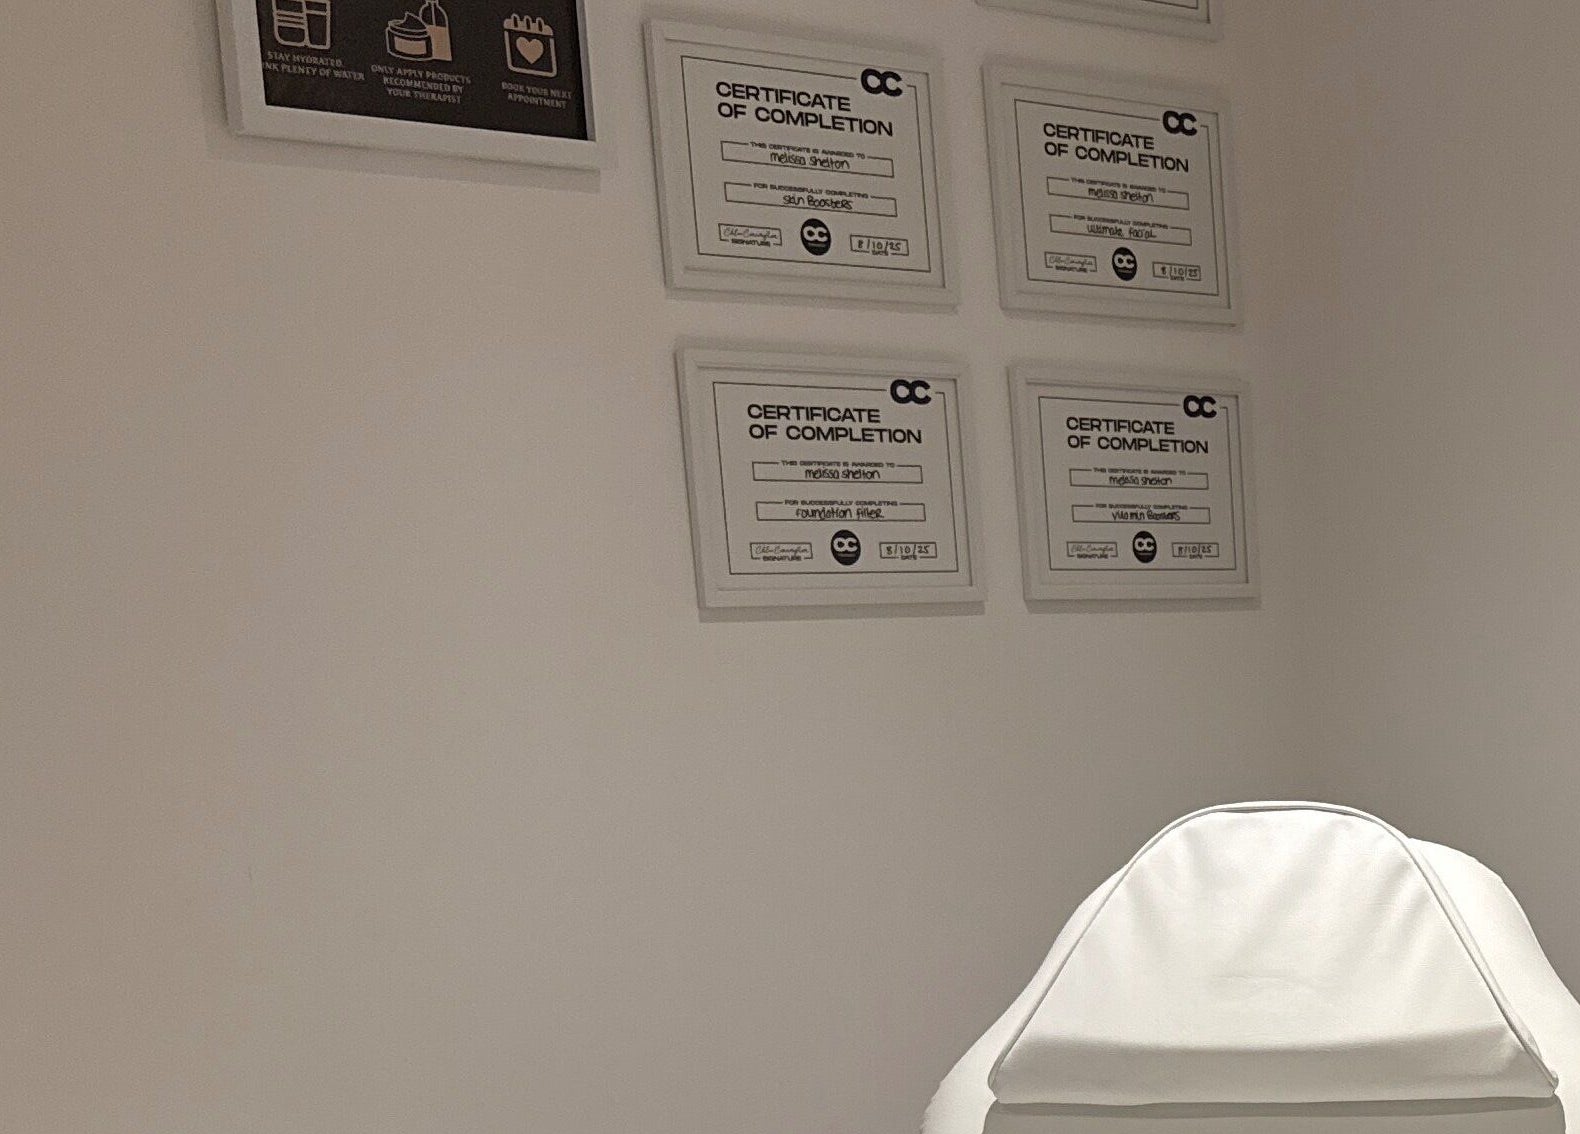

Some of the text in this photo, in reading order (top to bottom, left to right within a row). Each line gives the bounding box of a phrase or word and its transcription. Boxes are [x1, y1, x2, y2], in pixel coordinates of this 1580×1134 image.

[267, 50, 290, 61] STAY
[281, 63, 317, 76] PLENTY
[319, 68, 331, 77] OF
[333, 69, 365, 80] WATER
[370, 64, 471, 84] ONLY APPLY PRODUCTS
[383, 76, 463, 94] RECOMMENDED BY
[387, 87, 461, 104] YOUR THERAPIST
[507, 92, 567, 109] APPOINTMENT
[716, 81, 851, 112] CERTIFICATE
[718, 102, 893, 137] OF COMPLETION
[1043, 122, 1154, 150] CERTIFICATE
[1044, 142, 1189, 173] OF COMPLETION
[747, 404, 881, 424] CERTIFICATE
[749, 424, 922, 444] OF COMPLETION
[1066, 416, 1175, 435] CERTIFICATE
[1067, 435, 1209, 454] OF COMPLETION
